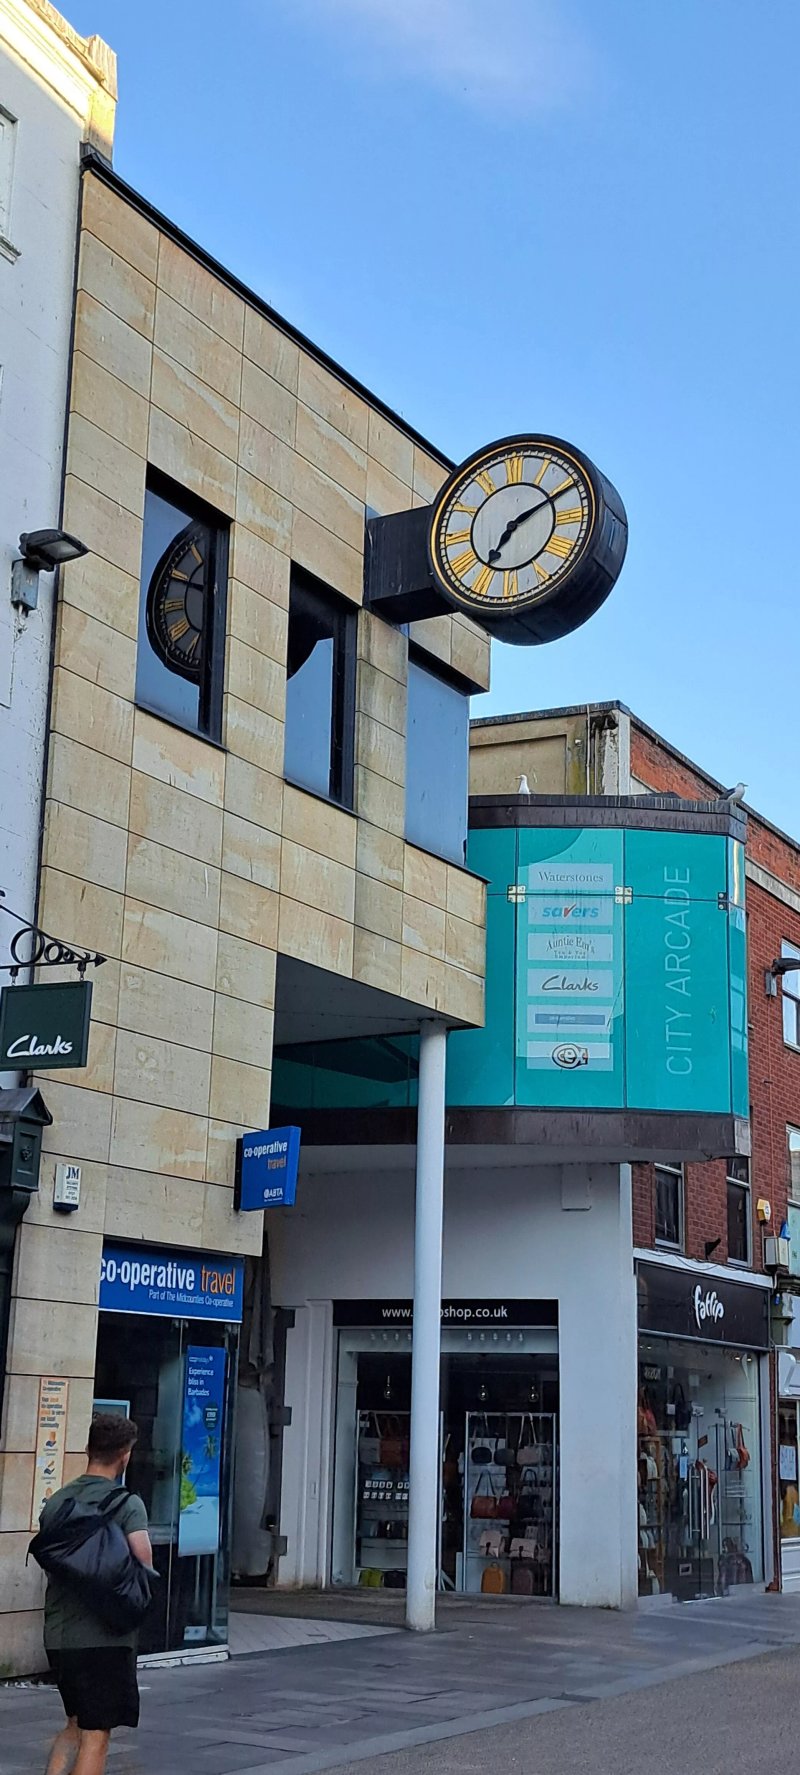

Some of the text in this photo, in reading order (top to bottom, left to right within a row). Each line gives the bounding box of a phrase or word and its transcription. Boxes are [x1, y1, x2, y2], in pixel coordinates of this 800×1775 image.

[556, 506, 583, 525] III
[538, 871, 604, 882] Waterstones
[541, 903, 599, 918] savers
[546, 935, 574, 952] Auntie
[663, 865, 693, 1075] CITY ARCADE
[541, 975, 599, 991] Clarks
[6, 1034, 73, 1058] Clarks
[243, 1140, 288, 1159] co-operative
[267, 1154, 287, 1170] travel
[66, 1166, 80, 1179] JM
[201, 1264, 236, 1295] travel
[148, 1289, 160, 1300] Part
[160, 1291, 166, 1300] of
[166, 1291, 176, 1301] The
[204, 1295, 235, 1308] Co-operative
[188, 1367, 214, 1376] Experience
[199, 1378, 205, 1386] in
[187, 1387, 210, 1397] Barbados
